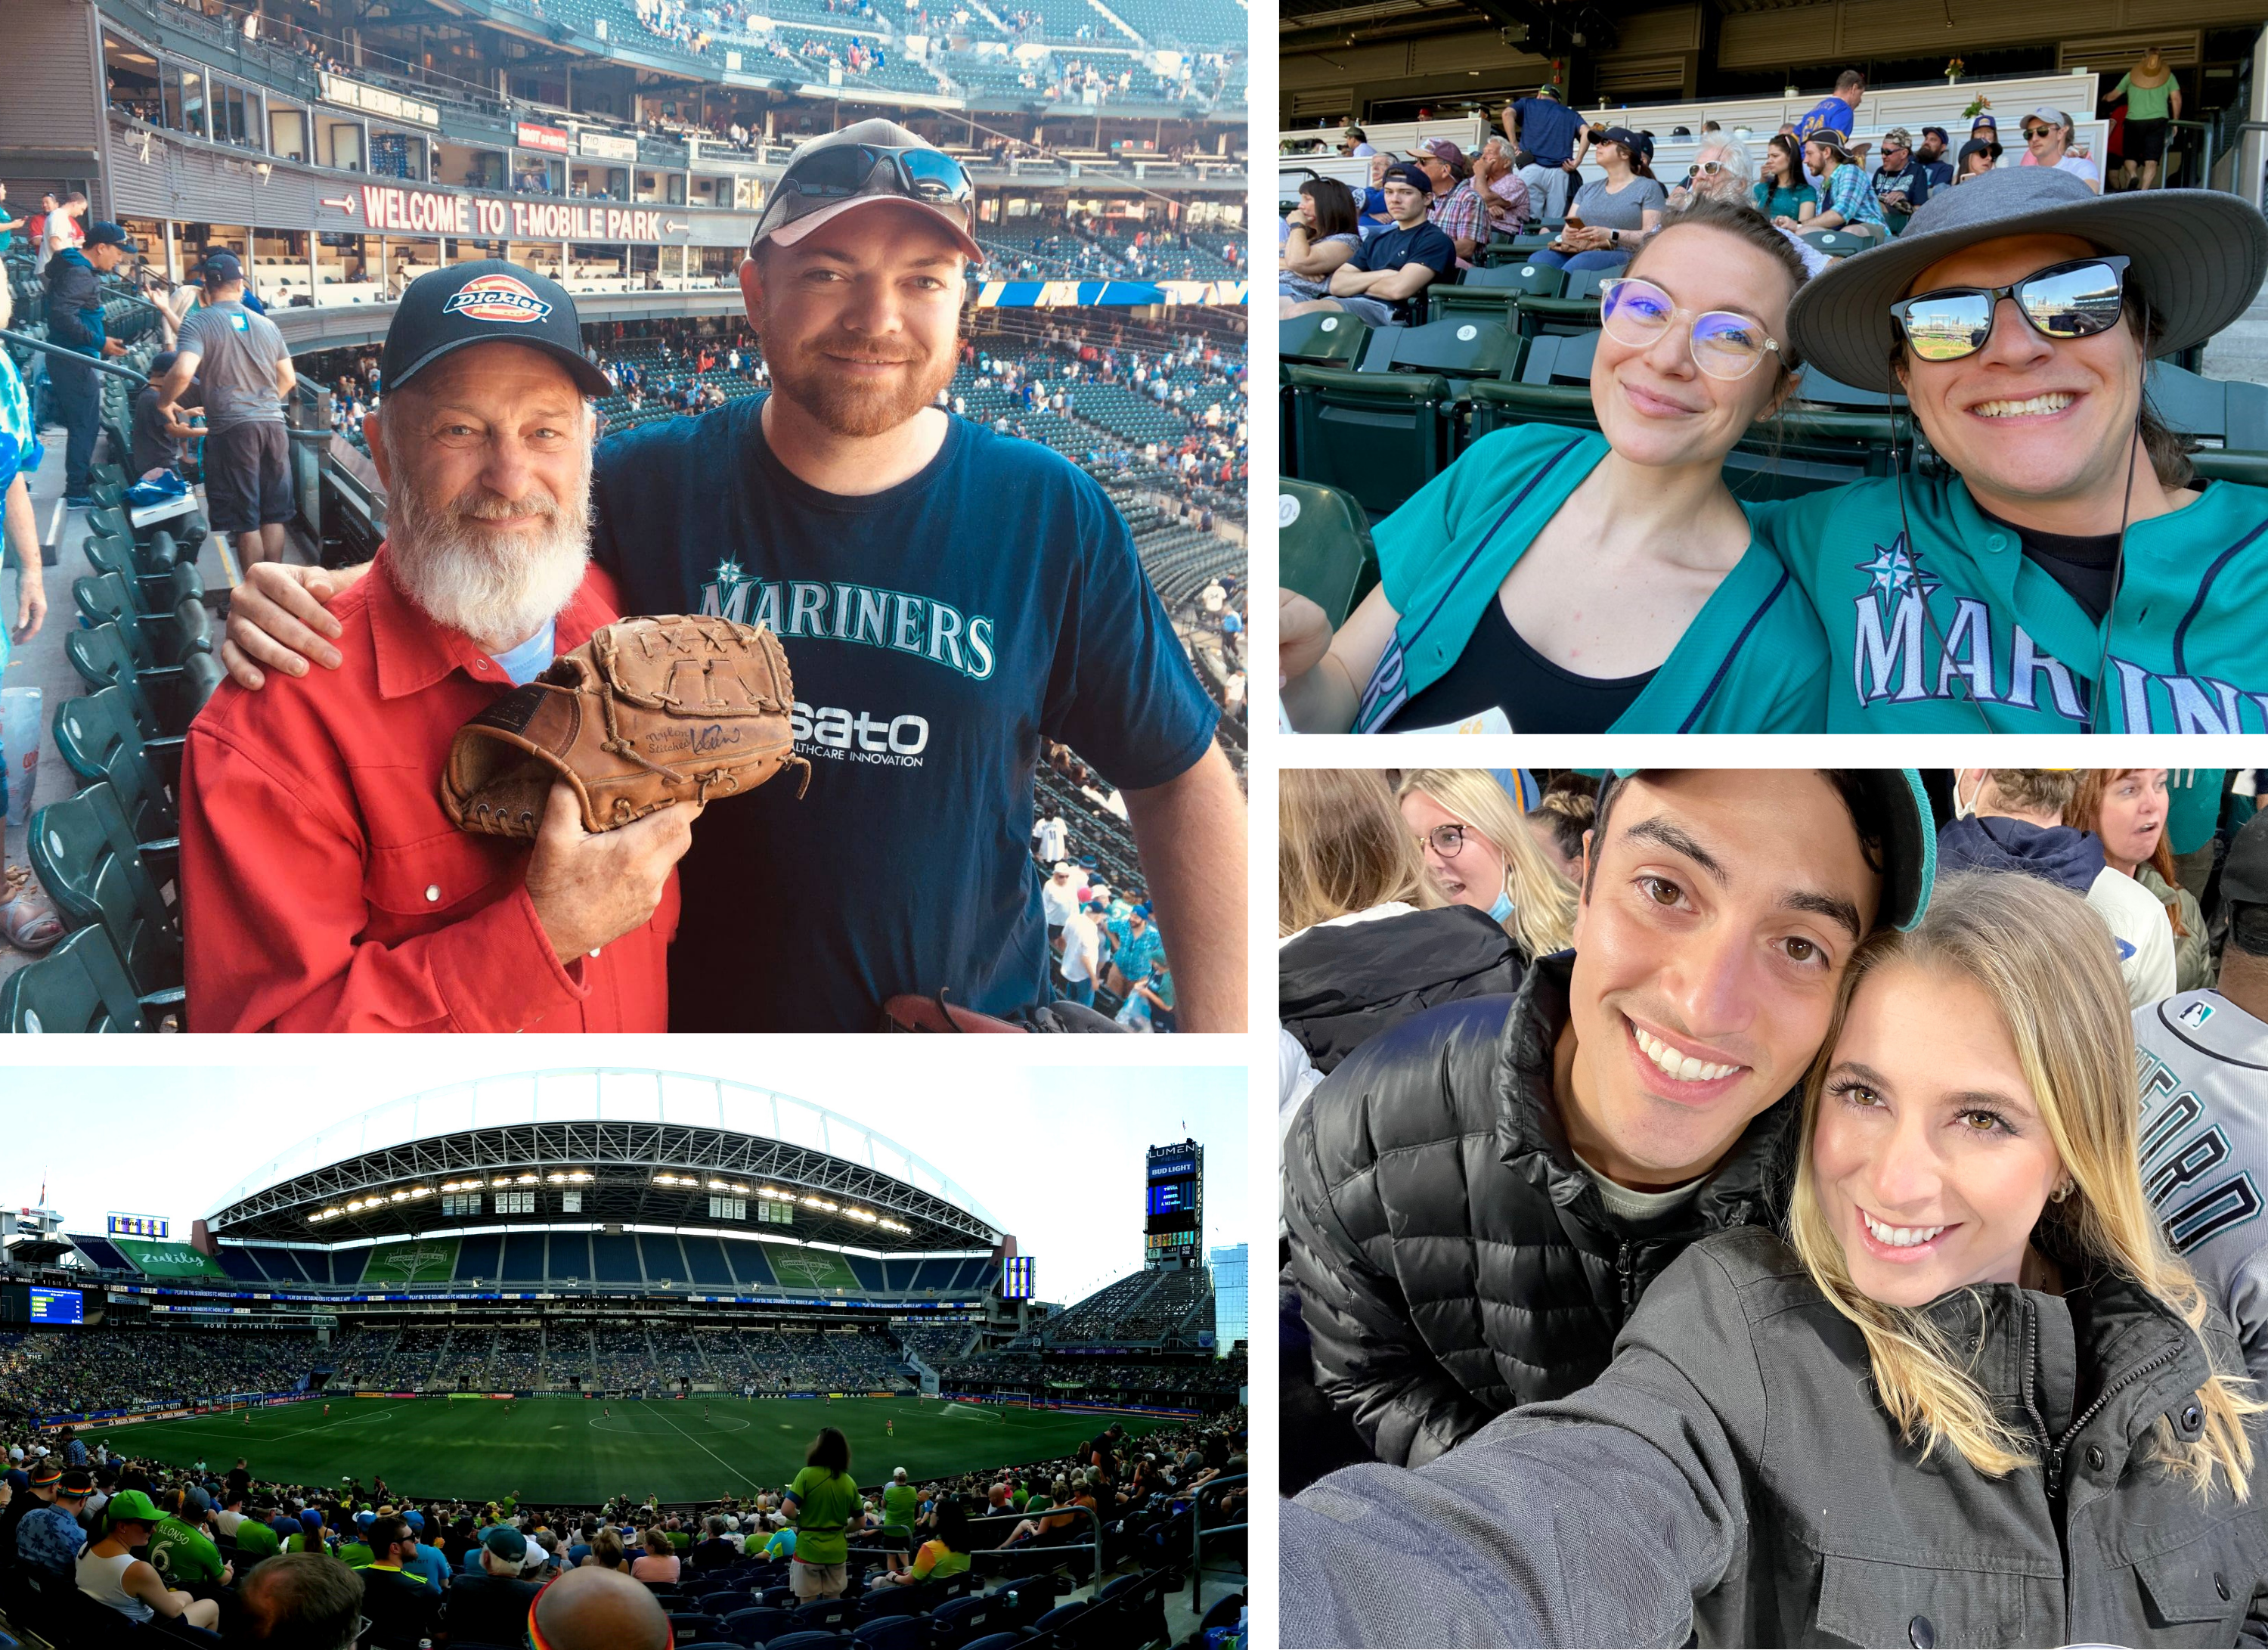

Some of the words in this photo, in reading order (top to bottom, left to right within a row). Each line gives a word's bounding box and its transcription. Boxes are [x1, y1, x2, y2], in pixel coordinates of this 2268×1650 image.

[519, 127, 541, 144] ROOT
[584, 135, 599, 146] 710
[361, 185, 470, 233] WELCOME
[475, 198, 506, 236] TO
[510, 201, 603, 238] T-MOBILE
[607, 209, 662, 240] PARK
[454, 291, 544, 312] Dickies
[1463, 329, 1470, 337] 9
[1279, 501, 1293, 520] 0
[699, 576, 996, 681] MARINERS
[649, 738, 691, 755] Stitched
[791, 743, 844, 761] ALTHCARE
[850, 751, 923, 768] INNOVATION
[1149, 1144, 1194, 1158] LUMEN
[2136, 1044, 2266, 1258] FORD
[1168, 1164, 1191, 1173] LIGHT
[158, 1524, 189, 1545] ALONSO
[151, 1540, 175, 1572] 6
